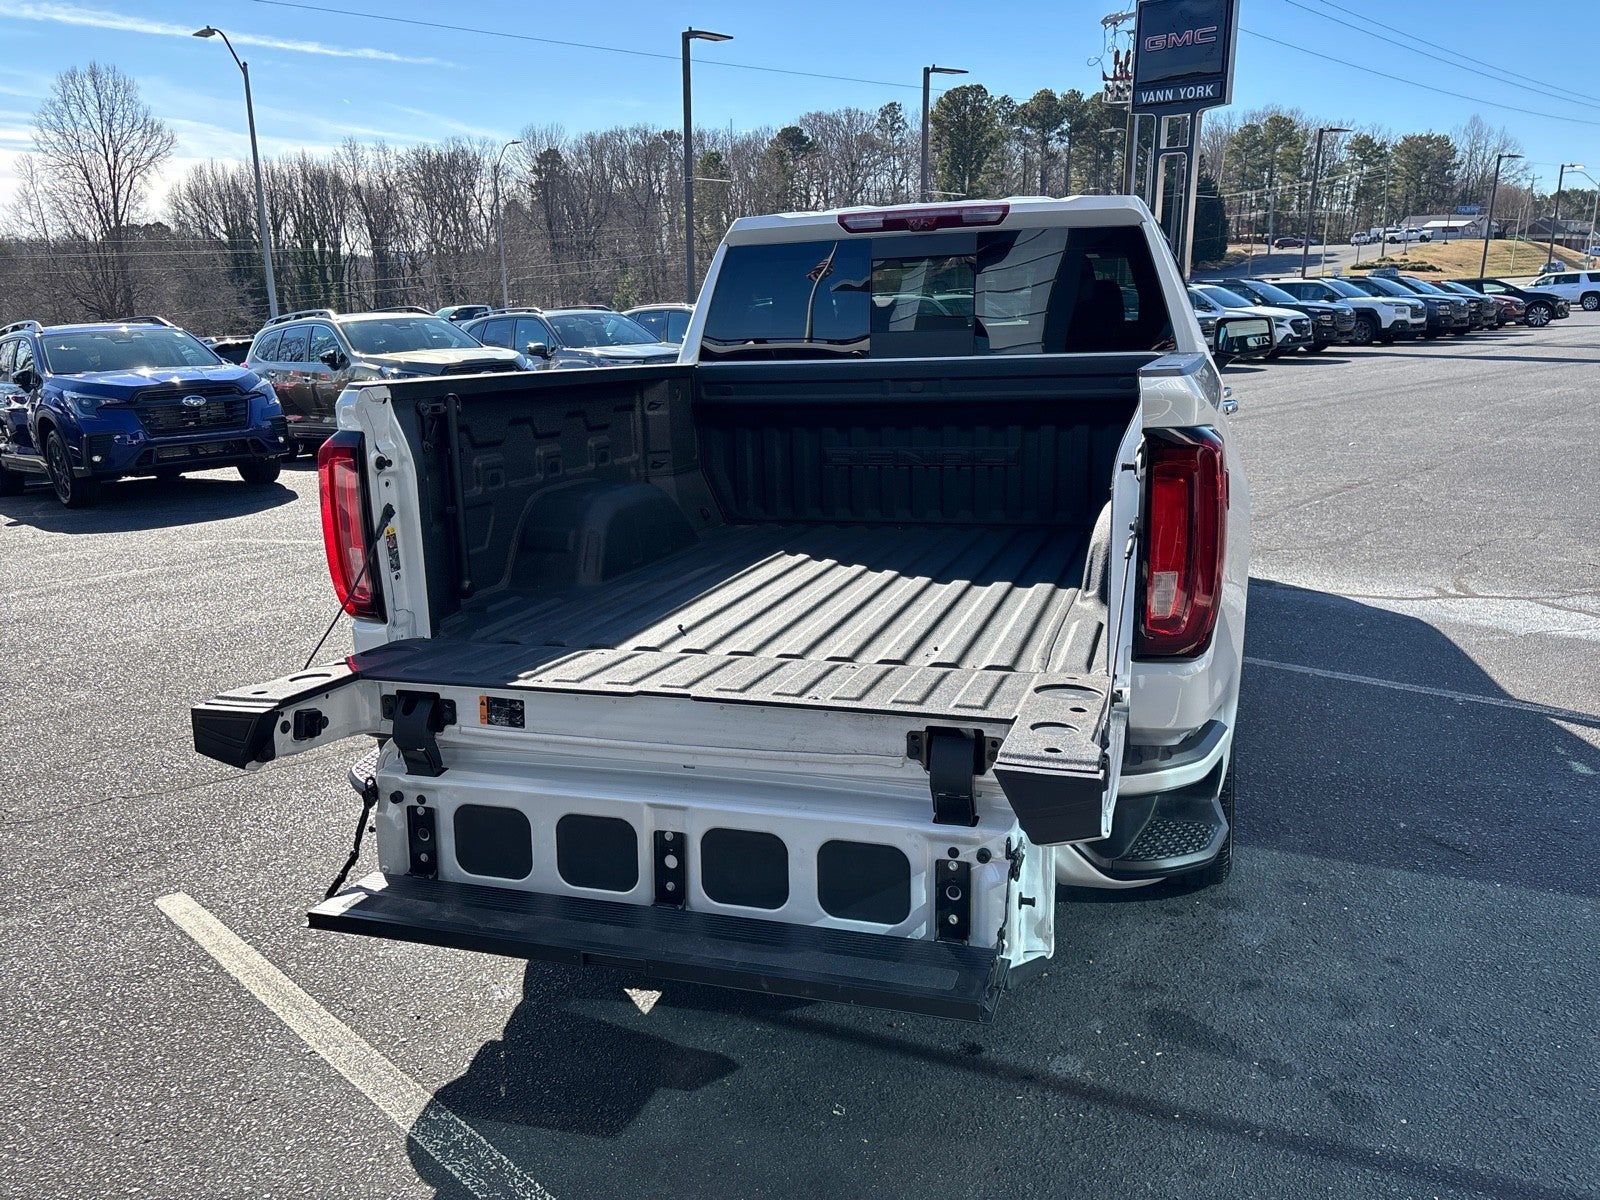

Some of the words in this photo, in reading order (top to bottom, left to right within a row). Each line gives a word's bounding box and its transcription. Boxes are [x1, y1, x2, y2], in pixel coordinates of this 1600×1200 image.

[1145, 26, 1217, 51] GMC
[1141, 89, 1173, 103] VANN
[1180, 84, 1214, 99] YORK
